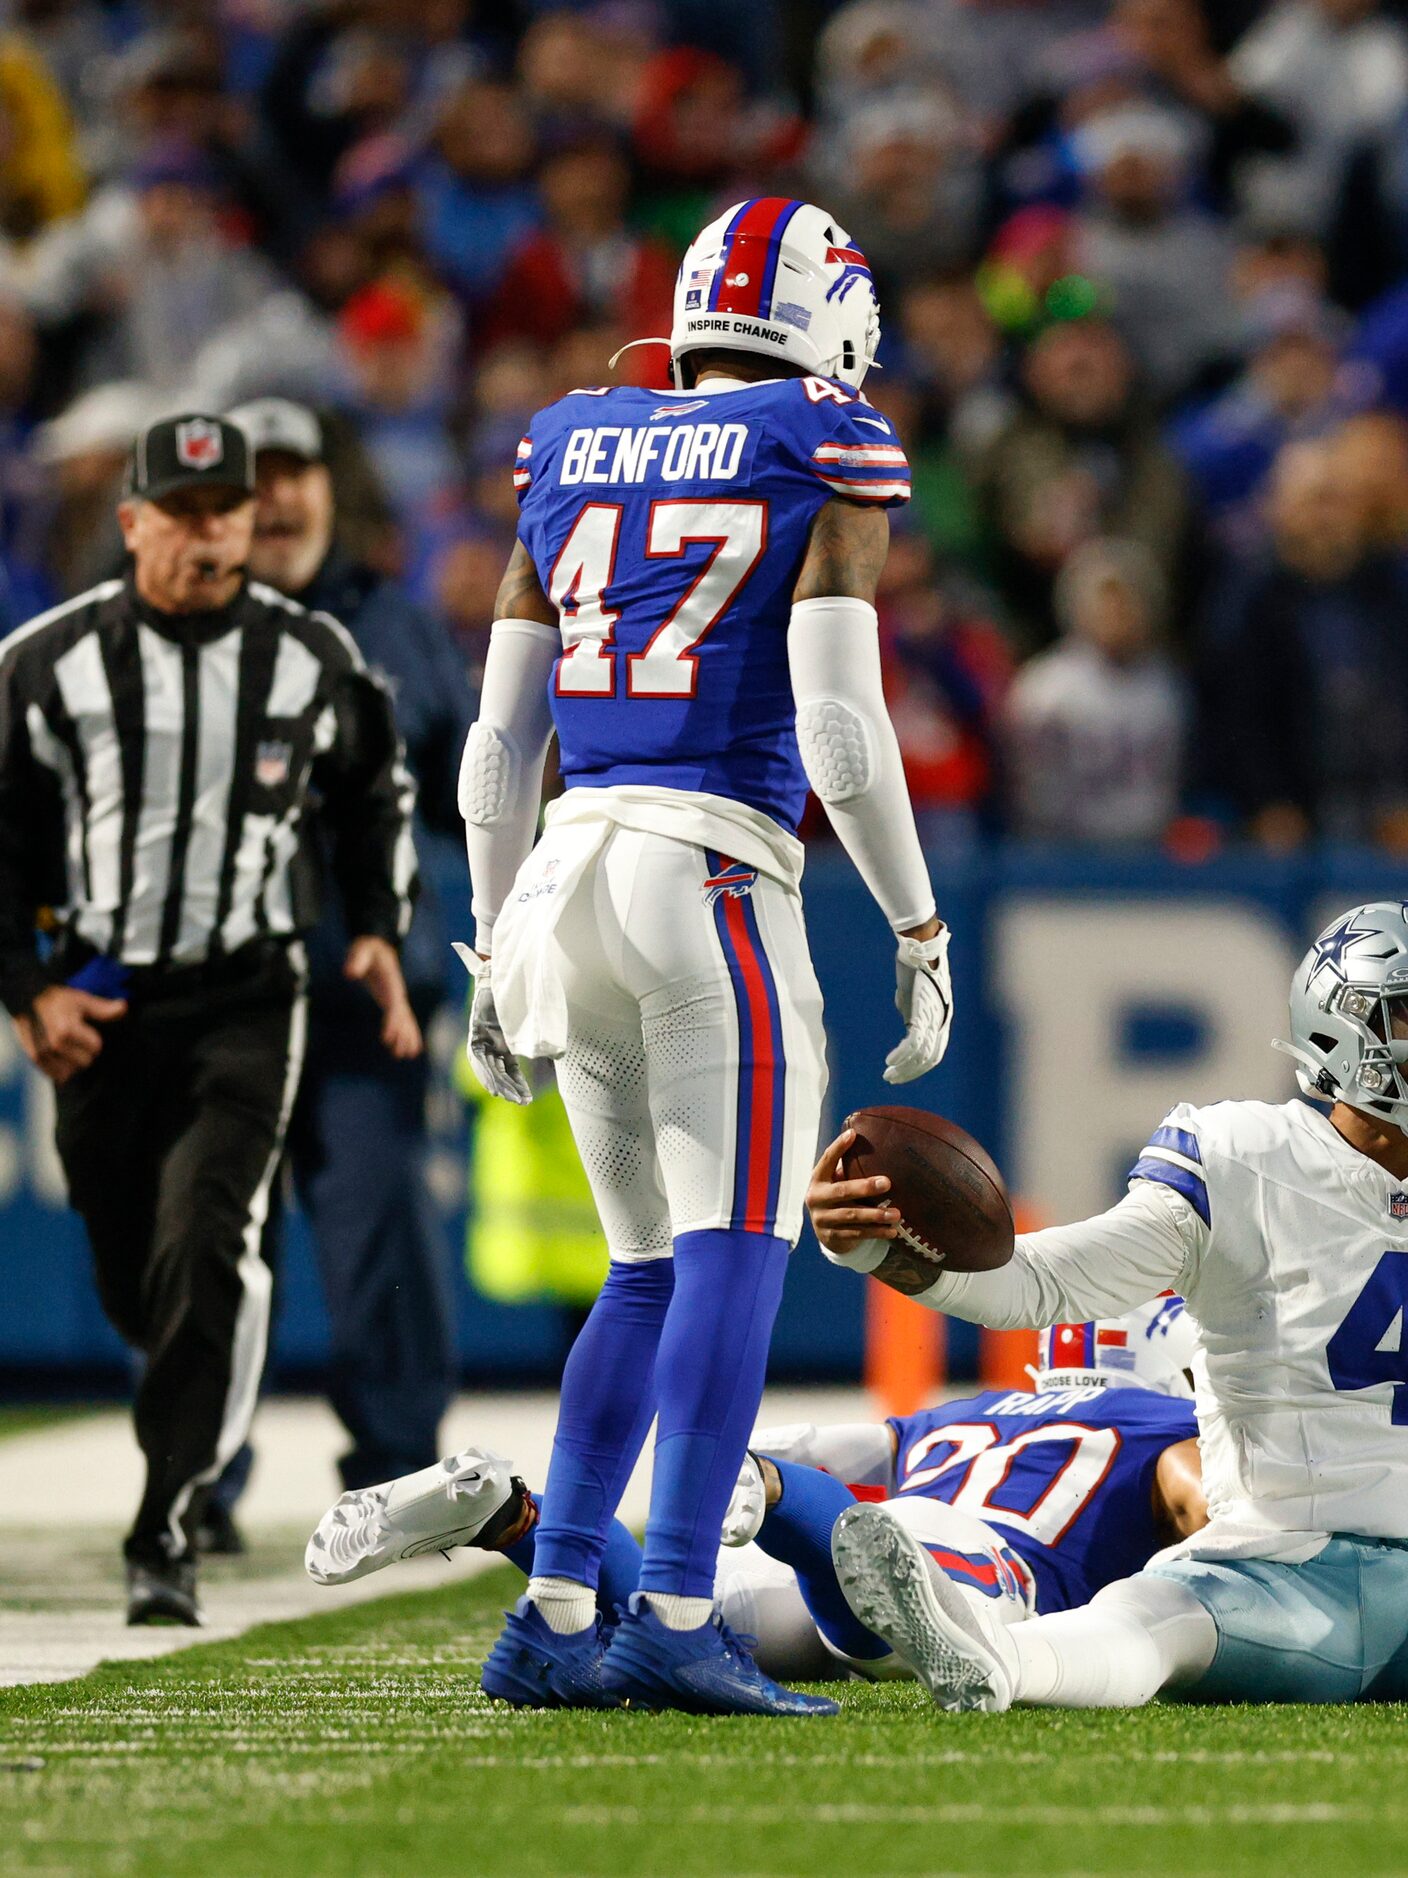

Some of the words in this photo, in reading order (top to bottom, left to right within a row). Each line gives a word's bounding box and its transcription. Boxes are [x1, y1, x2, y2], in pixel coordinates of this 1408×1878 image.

[687, 319, 730, 332] INSPIRE
[733, 322, 788, 346] CHANGE
[559, 423, 749, 486] BENFORD
[548, 499, 769, 699] 47
[1075, 1376, 1108, 1387] LOVE
[983, 1386, 1107, 1415] RAPP
